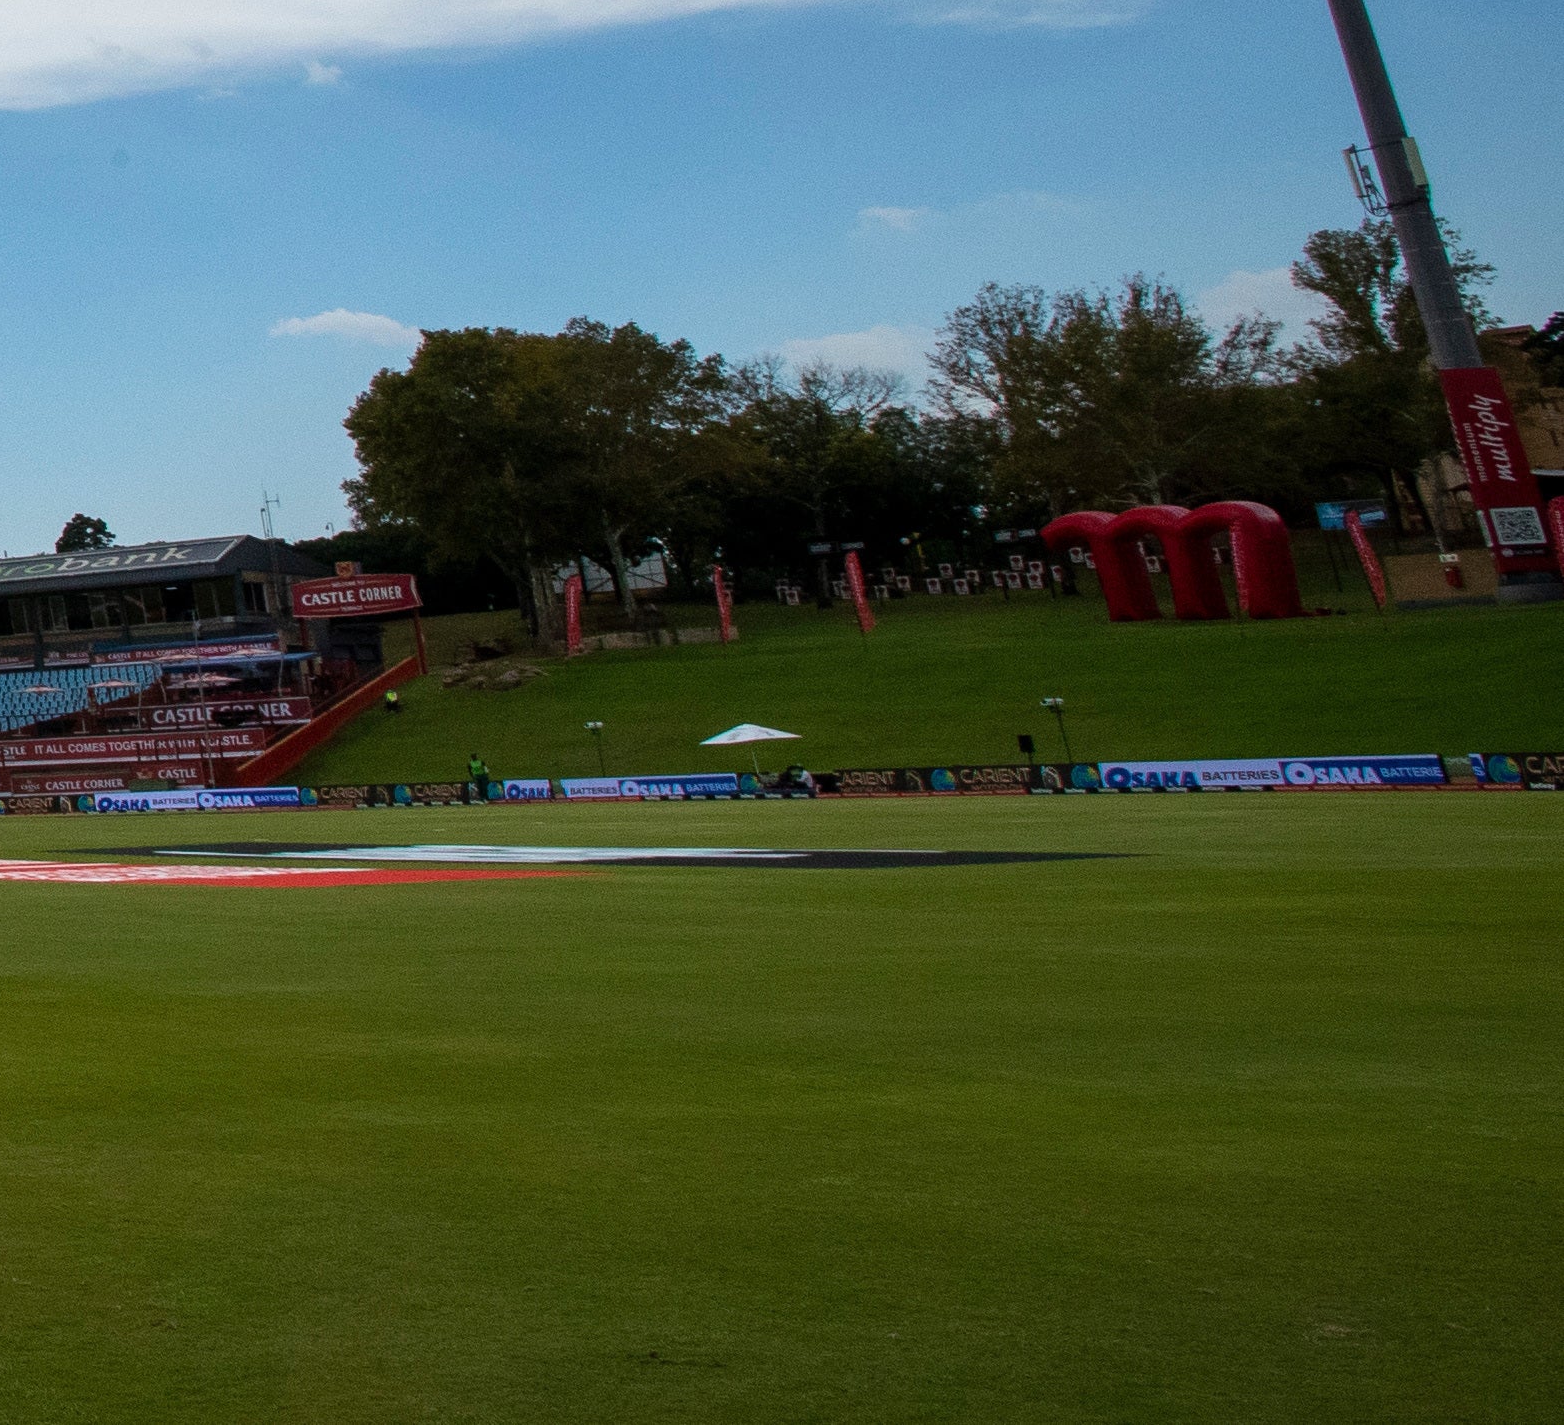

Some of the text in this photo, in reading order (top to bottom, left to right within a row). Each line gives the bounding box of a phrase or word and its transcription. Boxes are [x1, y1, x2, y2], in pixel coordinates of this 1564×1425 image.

[1468, 394, 1516, 482] multiply
[301, 585, 403, 606] CASTLE CORNER
[153, 707, 214, 723] CASTLE
[35, 746, 42, 754] IT
[44, 744, 63, 754] ALL
[68, 742, 105, 752] COMES
[158, 768, 197, 780] CASTLE
[961, 768, 1030, 784] CARIENT
[1105, 766, 1198, 788] OSAKA
[1202, 770, 1279, 782] BATTERIES
[1285, 762, 1382, 785] OSAKA
[46, 778, 124, 790] CASTLE CORNER
[571, 780, 737, 797] BATTERIES OSAKA BATTERIES
[97, 796, 150, 811] OSAKA
[153, 797, 195, 806] BATTERIES
[198, 792, 254, 807] OSAKA
